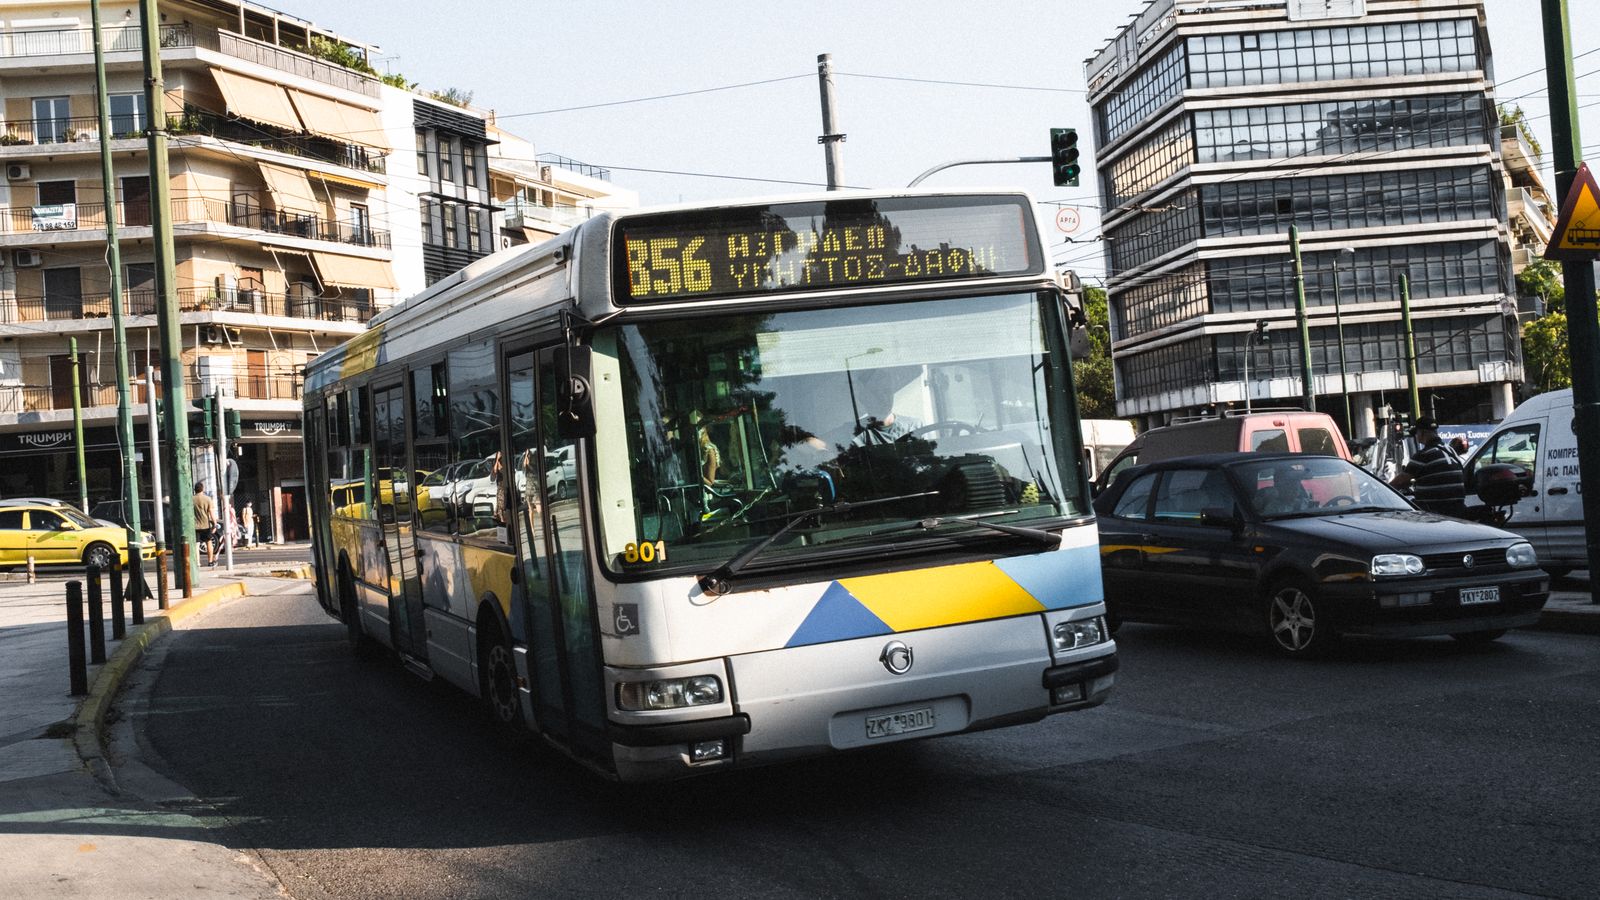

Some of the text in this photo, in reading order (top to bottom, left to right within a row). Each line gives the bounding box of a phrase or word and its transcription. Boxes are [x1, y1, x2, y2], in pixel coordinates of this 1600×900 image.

[254, 422, 286, 435] TRIUMPH
[18, 432, 72, 447] TRIUMPH
[625, 540, 666, 563] 801
